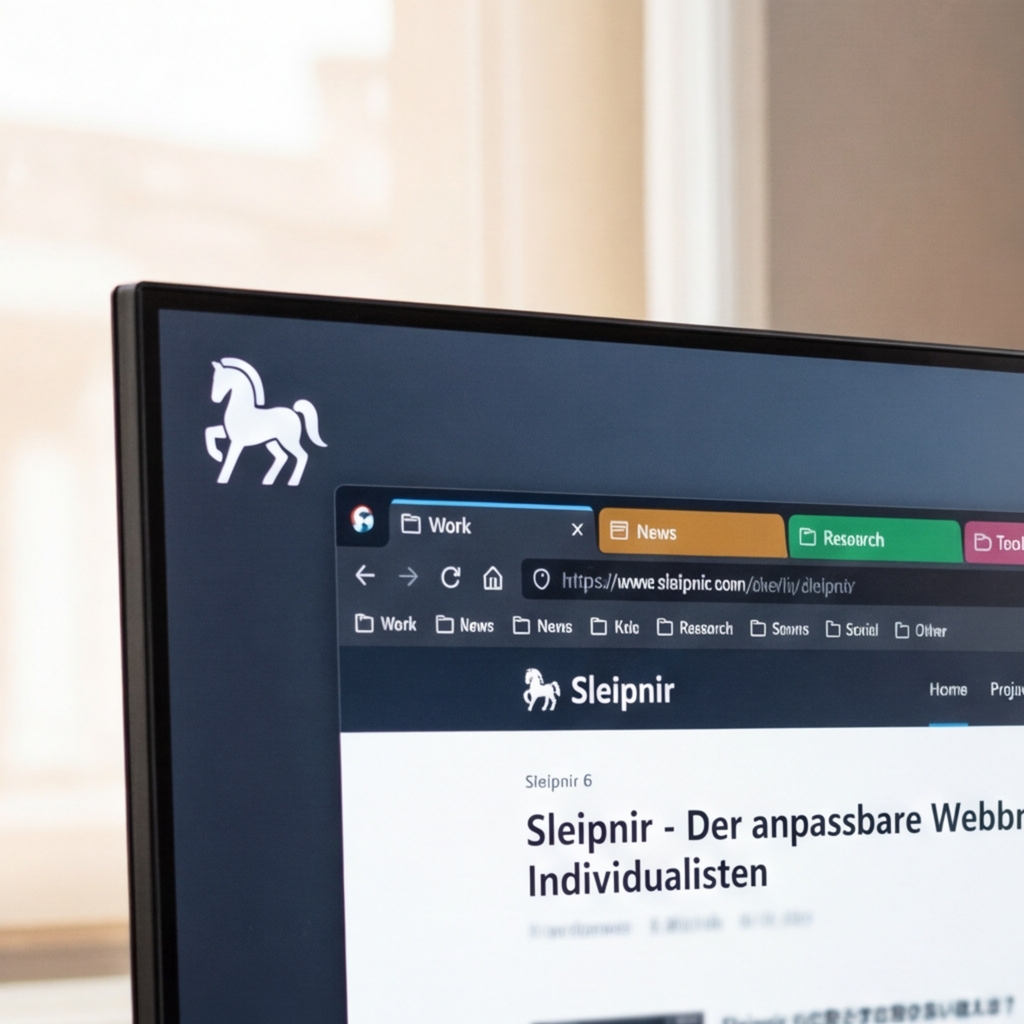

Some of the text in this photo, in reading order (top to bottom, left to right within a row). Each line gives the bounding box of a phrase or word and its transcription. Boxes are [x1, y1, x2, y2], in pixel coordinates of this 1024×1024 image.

[428, 516, 472, 535] Work
[637, 524, 677, 541] News
[380, 616, 417, 632] Work
[460, 617, 494, 633] News
[571, 674, 675, 712] Sleipnir
[929, 682, 968, 697] Home
[525, 773, 593, 792] Sleipnir 6
[527, 810, 653, 854] Sleipnir
[687, 809, 743, 841] Der
[752, 803, 922, 847] anpassbare
[529, 857, 768, 897] Individualisten
